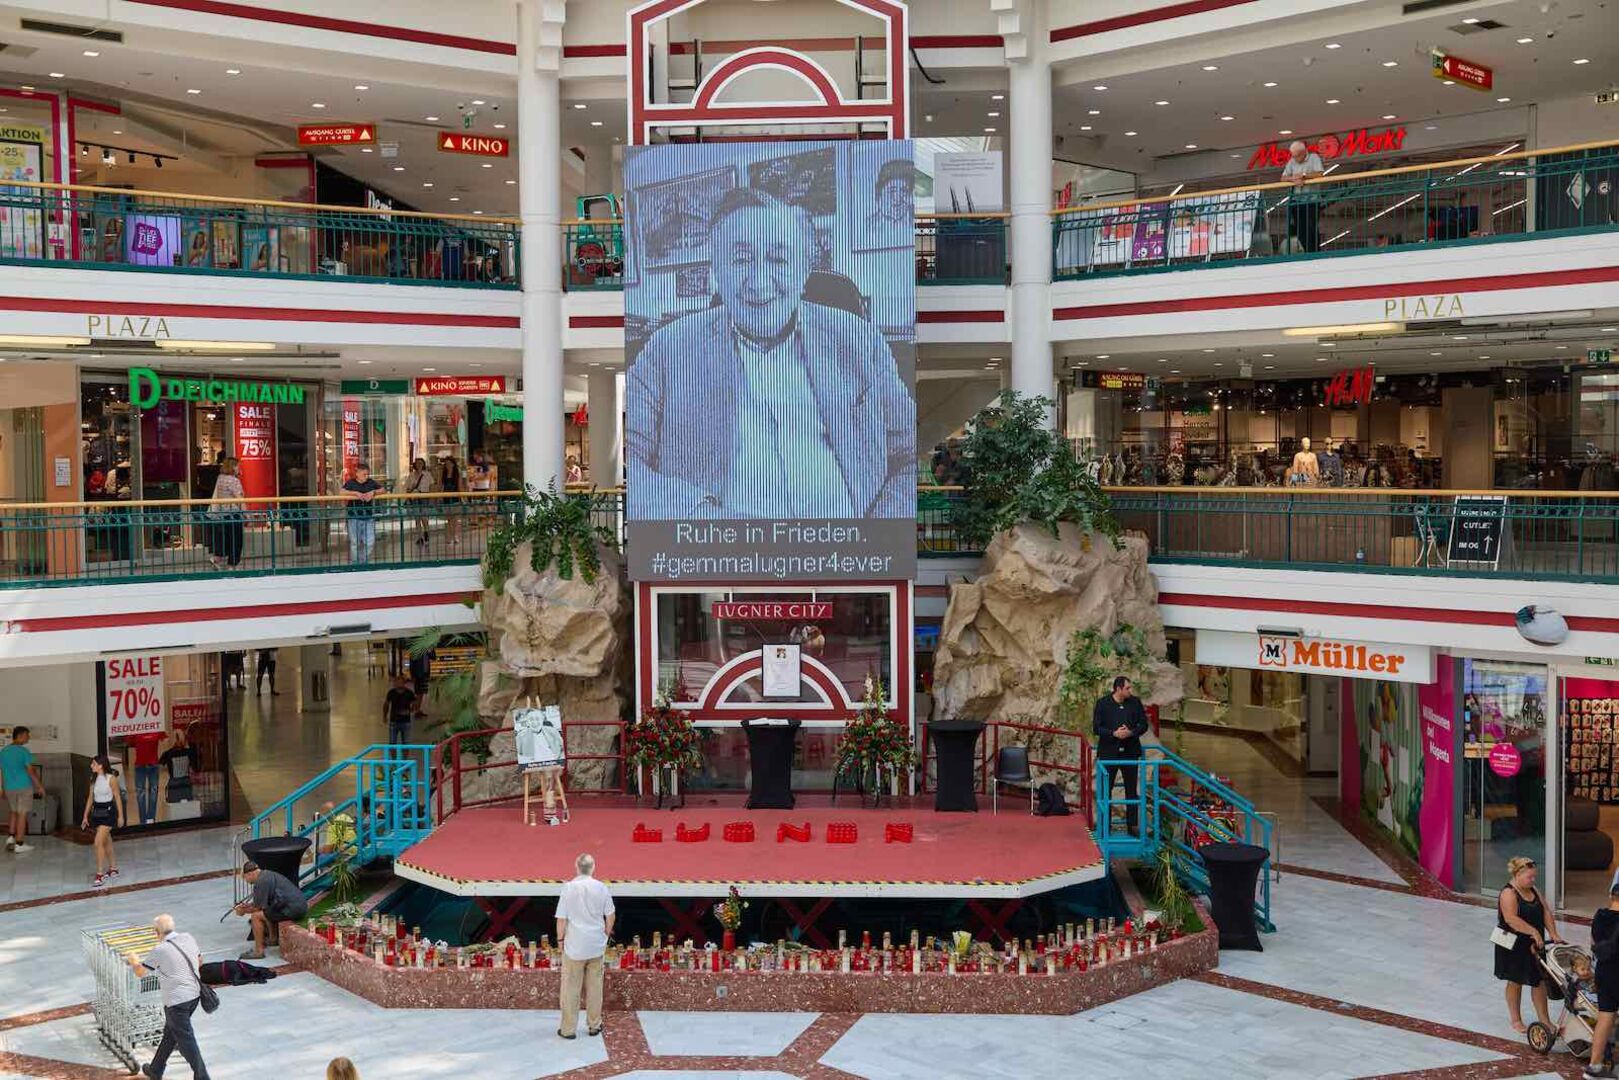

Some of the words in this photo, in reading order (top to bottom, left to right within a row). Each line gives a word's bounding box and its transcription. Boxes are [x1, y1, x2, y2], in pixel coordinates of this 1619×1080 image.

[0, 127, 41, 141] KTION
[462, 137, 503, 153] KINO
[1339, 126, 1407, 157] Markt
[1385, 295, 1464, 320] PLAZA
[88, 315, 170, 338] PLAZA
[167, 378, 304, 404] DEICHMANN
[430, 381, 457, 391] KINO
[239, 406, 271, 419] SALE
[240, 439, 271, 457] 75%
[676, 522, 738, 544] Ruhe
[745, 522, 764, 544] in
[772, 521, 868, 544] Frieden.
[652, 551, 893, 579] #gemmalugner4ever
[788, 604, 827, 618] CITY
[108, 656, 161, 679] SALE
[1266, 644, 1280, 658] M
[1292, 640, 1406, 674] Müller
[109, 686, 160, 721] 70%
[110, 721, 161, 734] REDUZIERT
